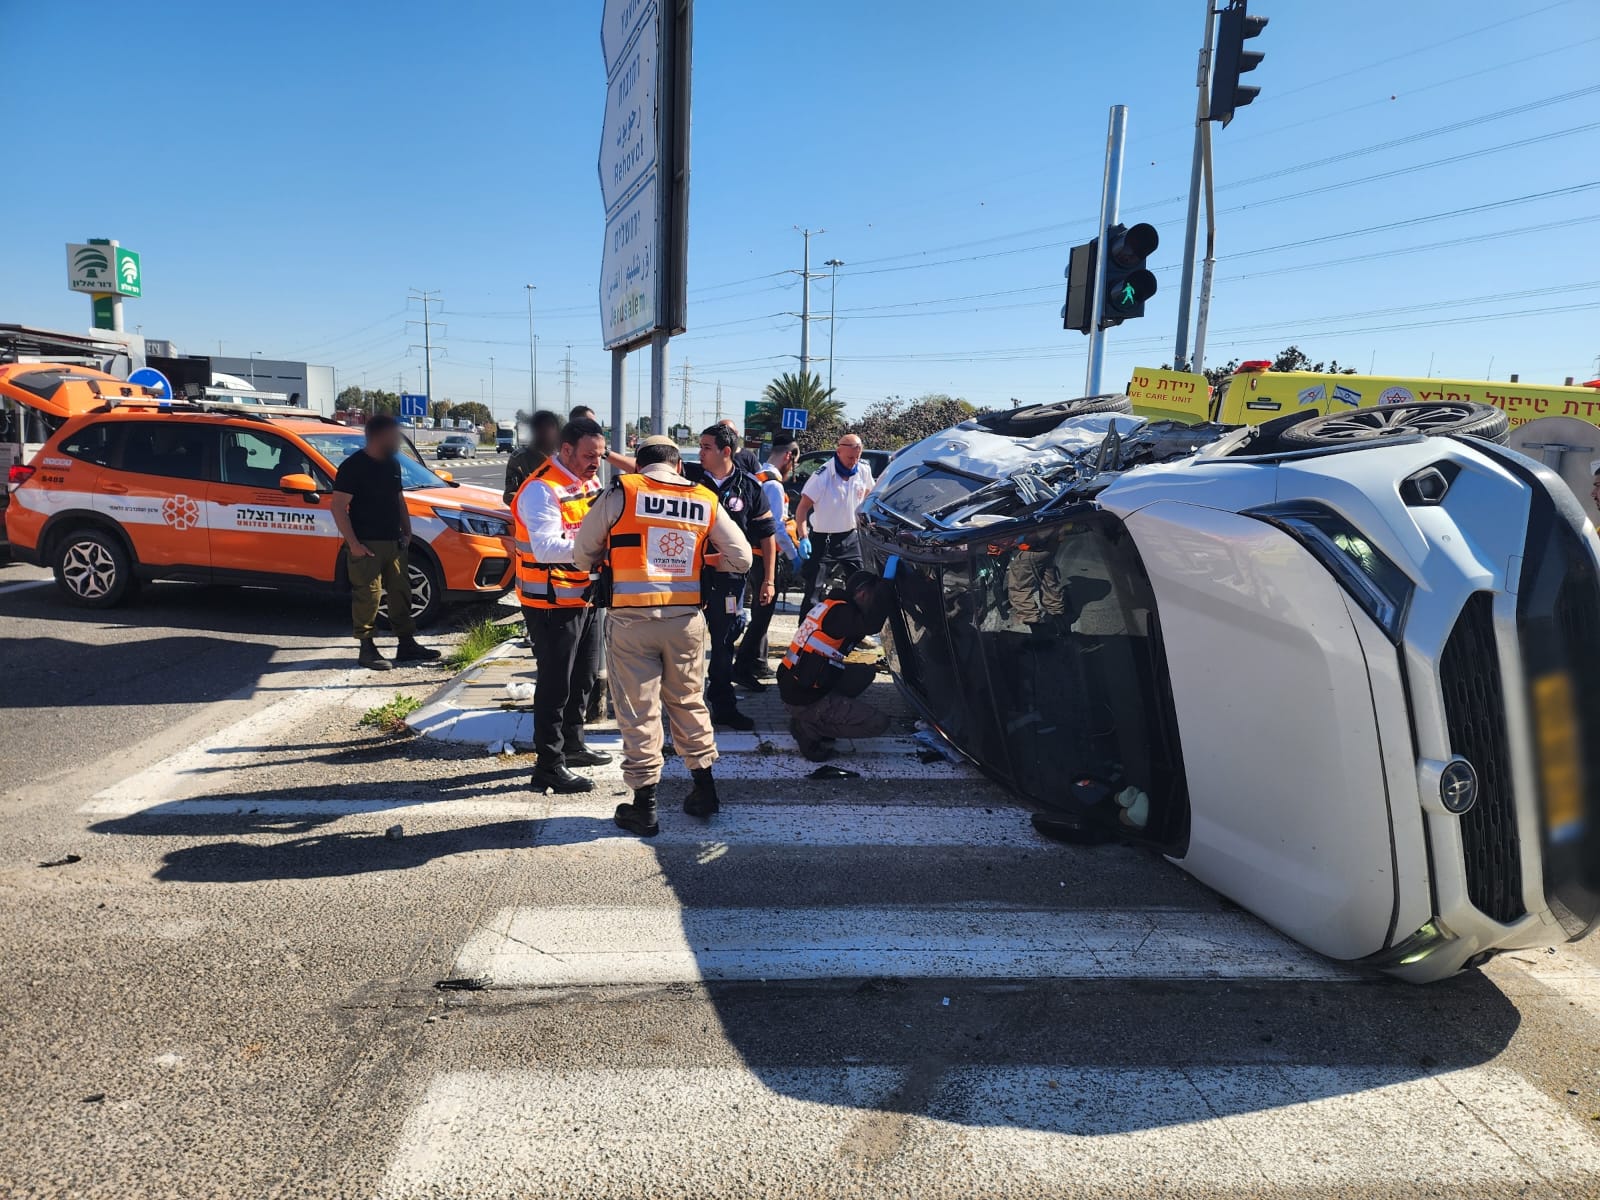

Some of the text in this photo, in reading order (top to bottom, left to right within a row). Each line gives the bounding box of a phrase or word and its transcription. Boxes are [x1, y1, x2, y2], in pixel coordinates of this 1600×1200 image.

[621, 0, 641, 36] Yavn
[618, 53, 640, 109] רחובות
[614, 132, 644, 188] Rehovot
[614, 210, 640, 254] ירושלים
[1146, 392, 1168, 400] CARE
[1156, 379, 1195, 393] ניידת
[237, 508, 315, 524] איחוד הצלה
[645, 496, 704, 520] חובש
[237, 520, 315, 531] UNITED HATZALAH
